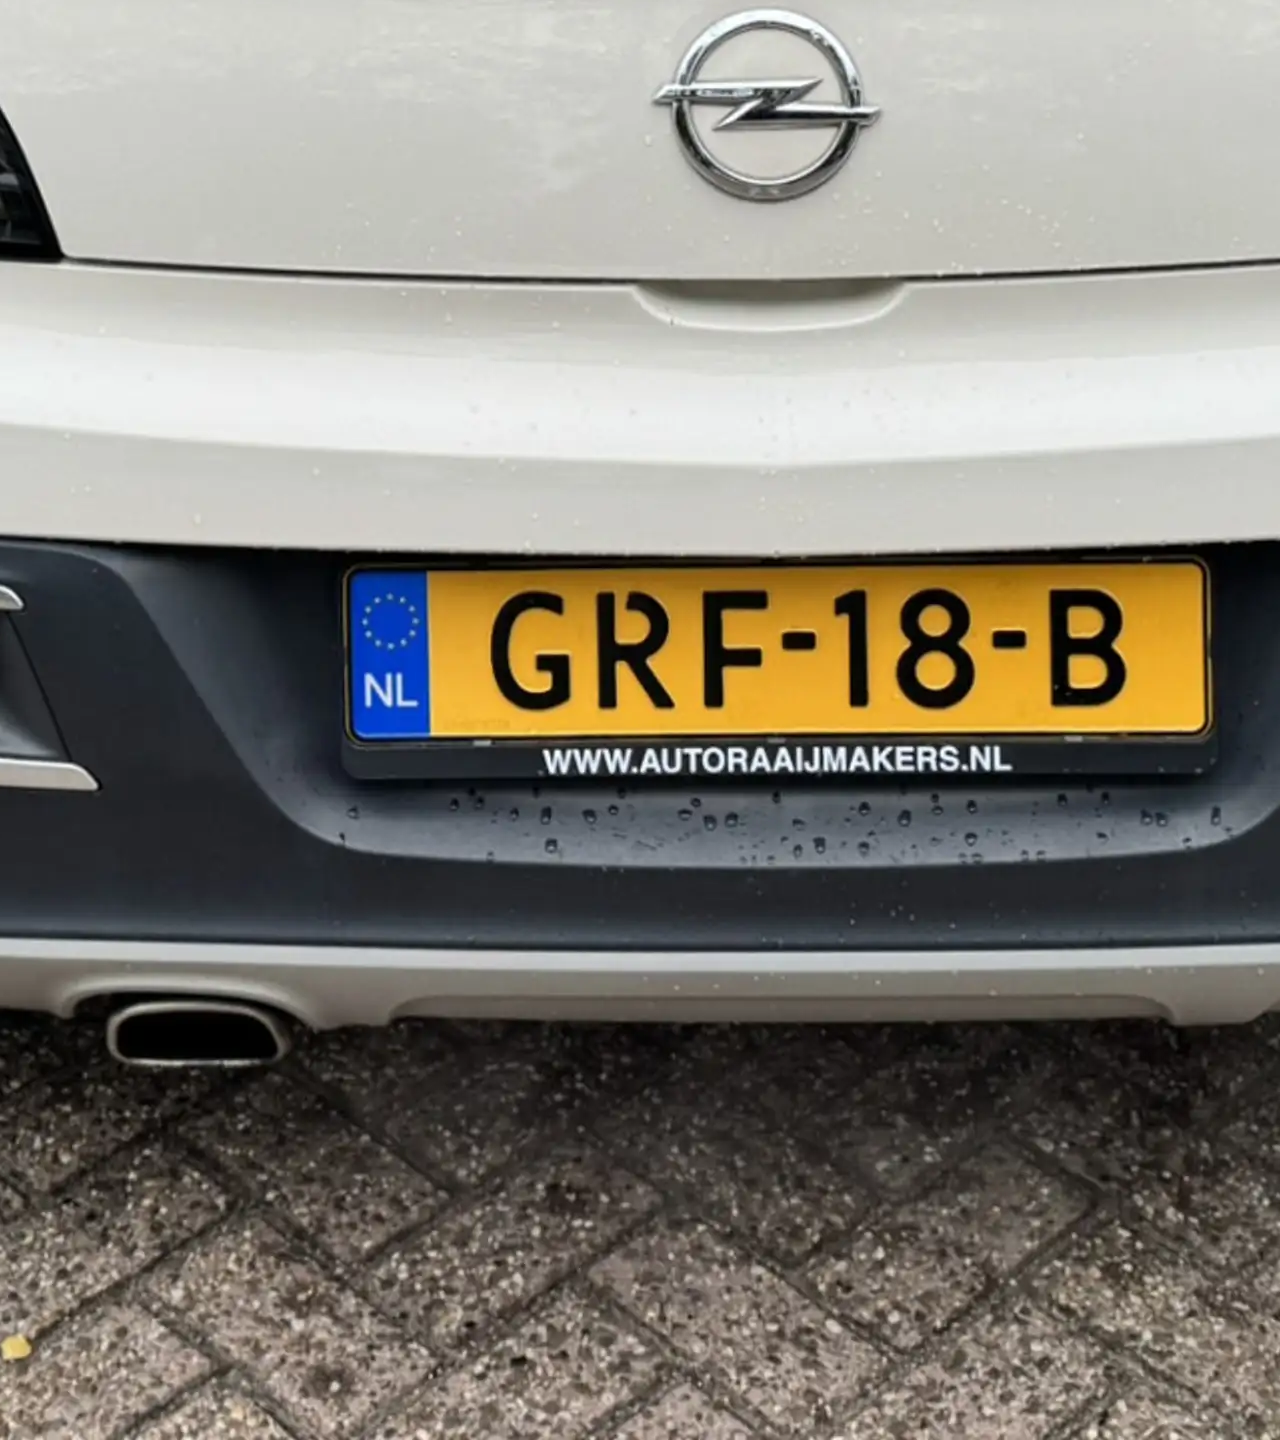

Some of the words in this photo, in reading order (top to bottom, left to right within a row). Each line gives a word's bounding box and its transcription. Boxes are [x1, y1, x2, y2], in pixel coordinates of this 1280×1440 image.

[489, 587, 1128, 712] GRF-18-B
[364, 672, 419, 709] NL
[542, 745, 1013, 776] WWW.AUTORAAIJMAKERS.NL
